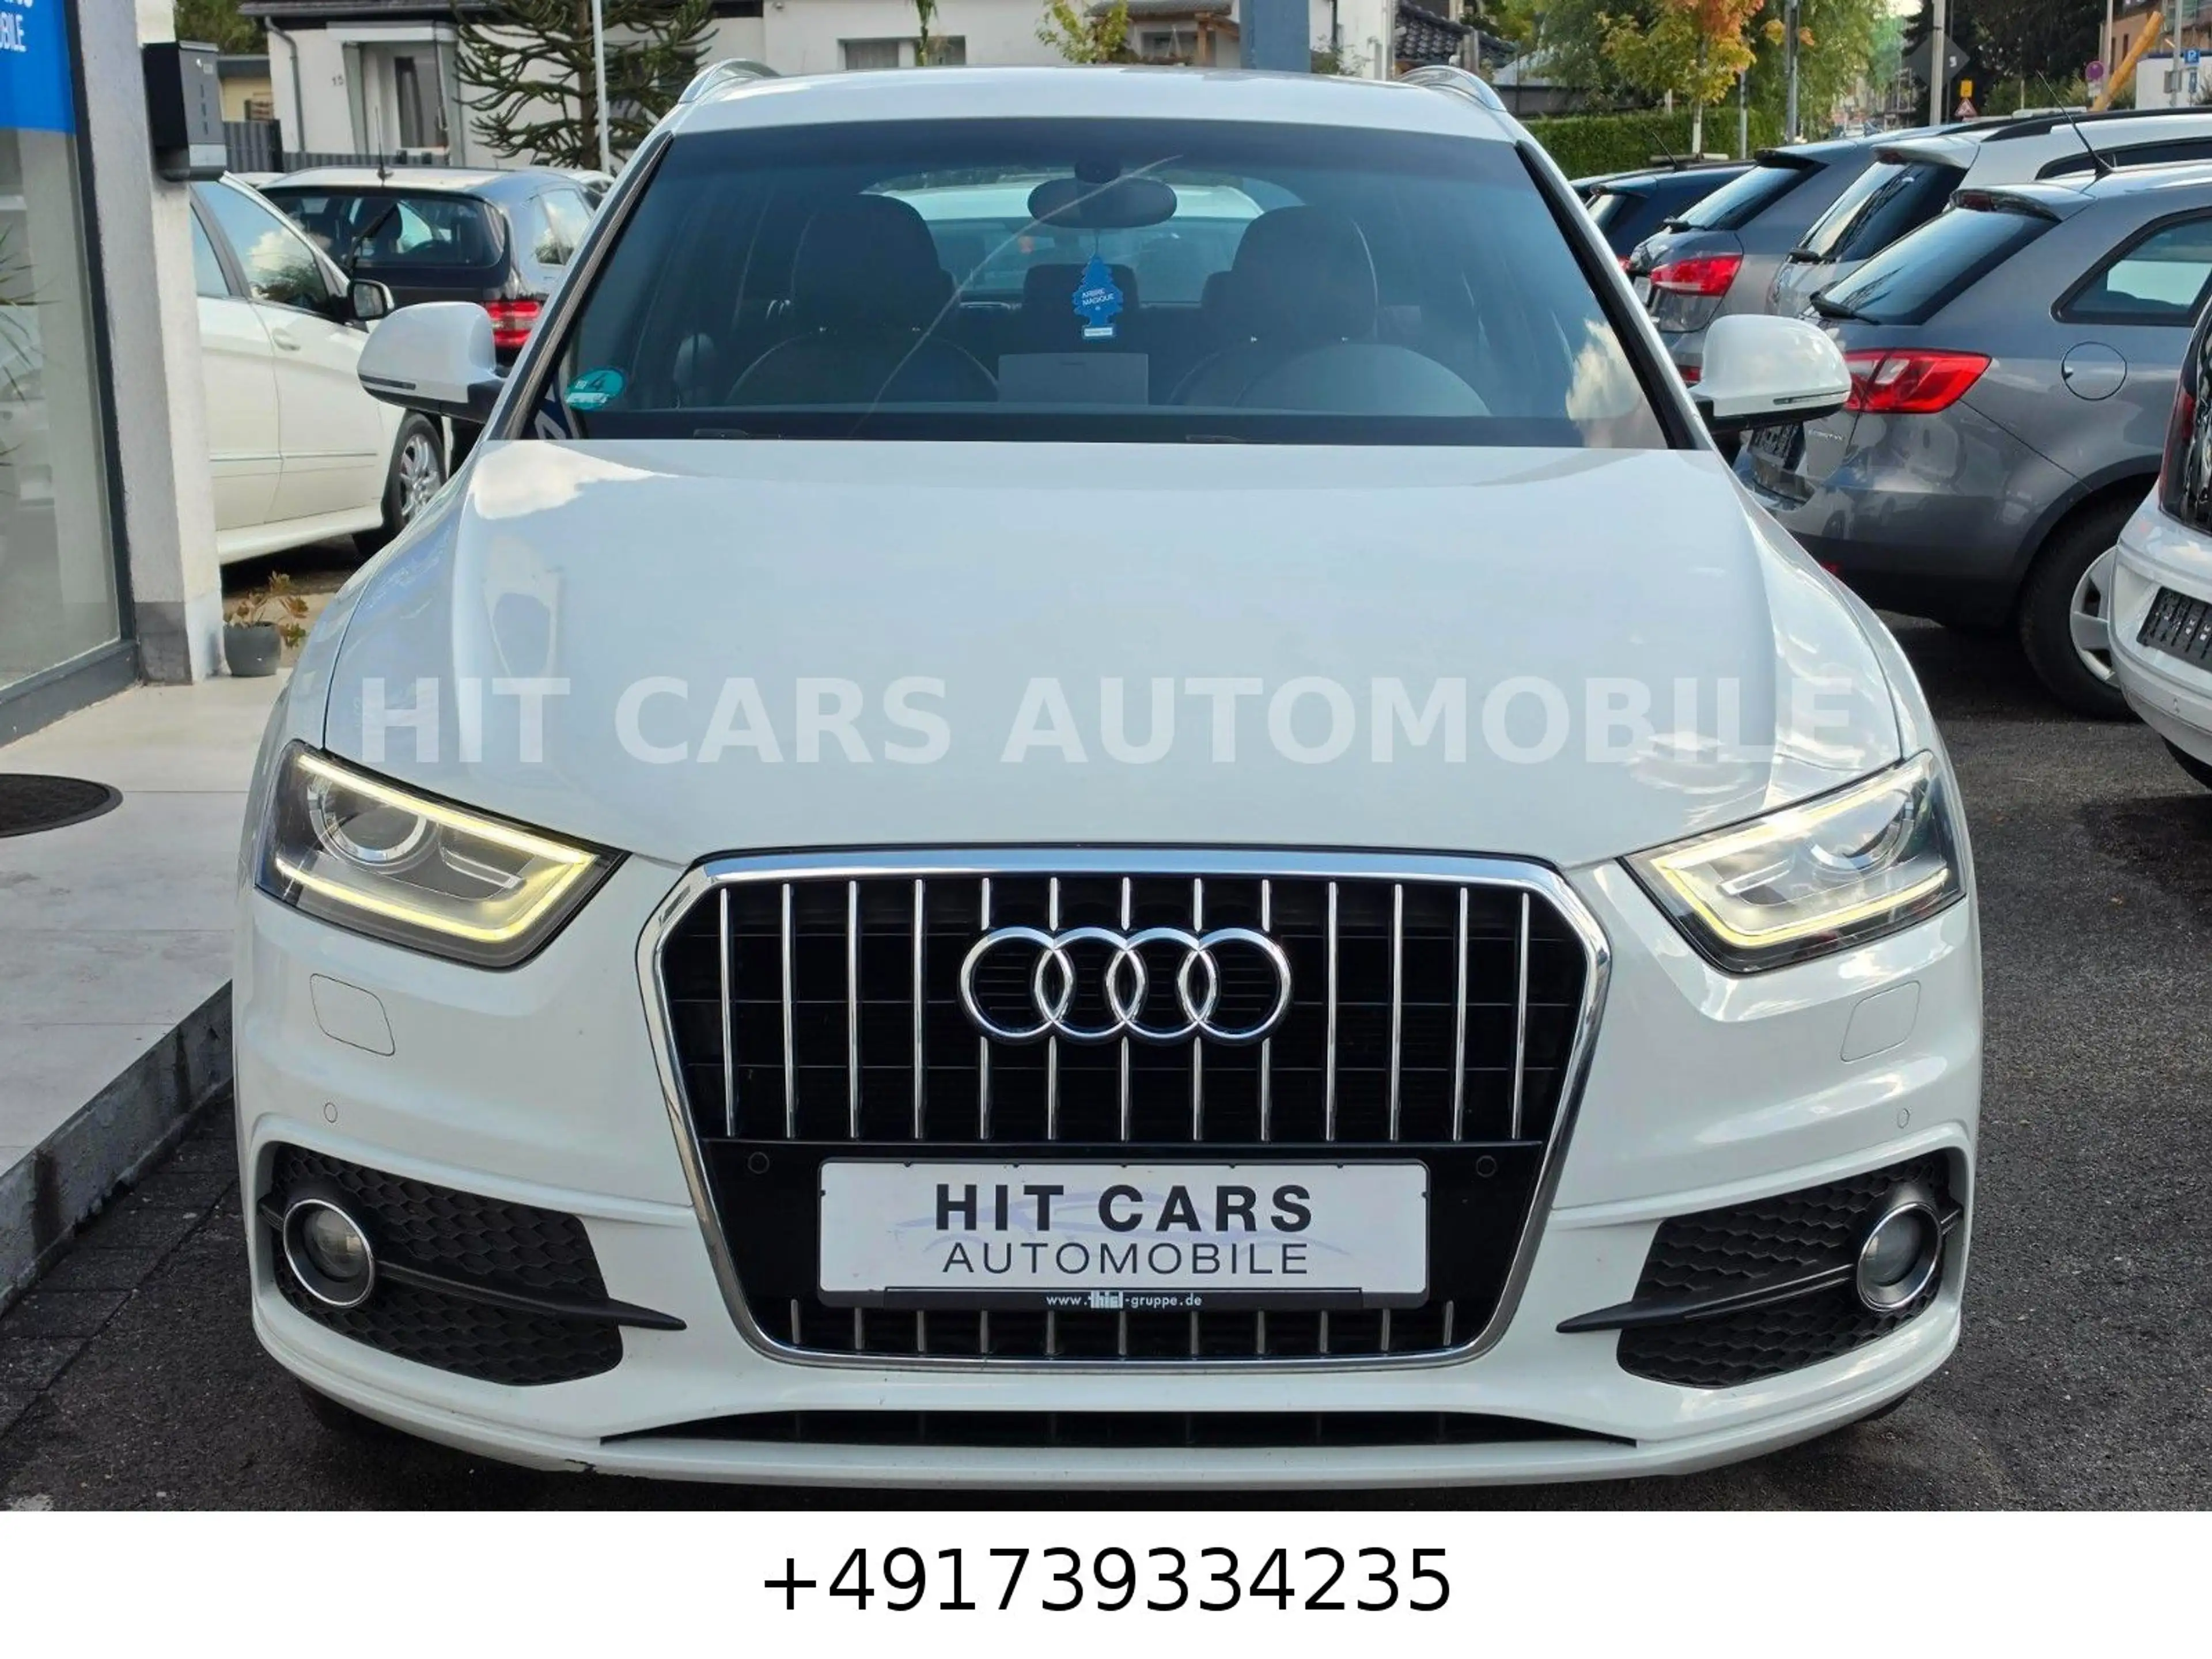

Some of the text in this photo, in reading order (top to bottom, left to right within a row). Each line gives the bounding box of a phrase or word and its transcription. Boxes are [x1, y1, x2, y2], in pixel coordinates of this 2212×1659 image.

[935, 1183, 1312, 1233] HIT CARS
[942, 1242, 1308, 1274] AUTOMOBILE
